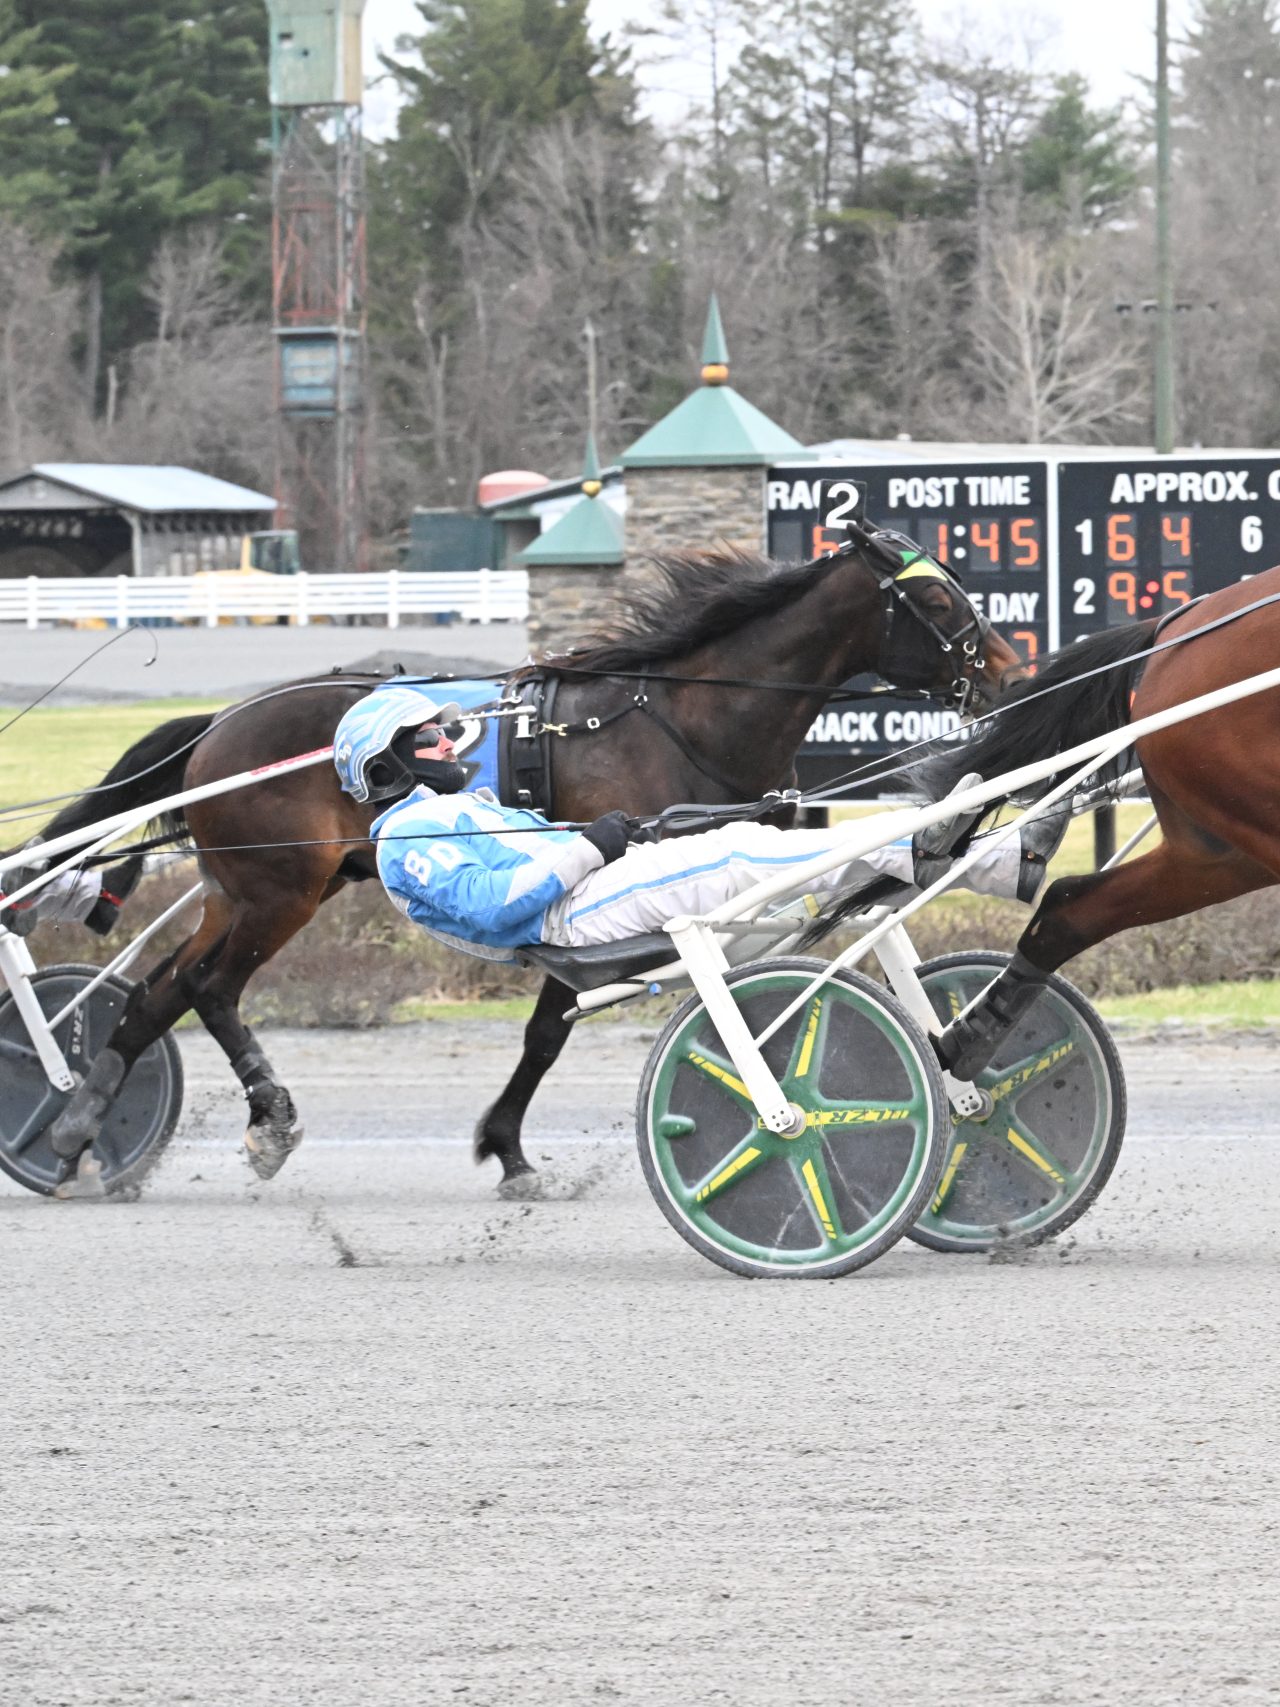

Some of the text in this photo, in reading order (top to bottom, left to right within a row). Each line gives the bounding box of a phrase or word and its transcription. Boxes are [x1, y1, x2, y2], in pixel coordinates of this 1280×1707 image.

[888, 475, 1031, 509] POST TIME
[1110, 470, 1258, 503] APPROX.
[825, 482, 860, 530] 2
[1074, 519, 1093, 556] 1
[1240, 515, 1263, 553] 6
[989, 592, 1039, 622] DAY
[1073, 578, 1096, 615] 2
[804, 711, 879, 743] RACK
